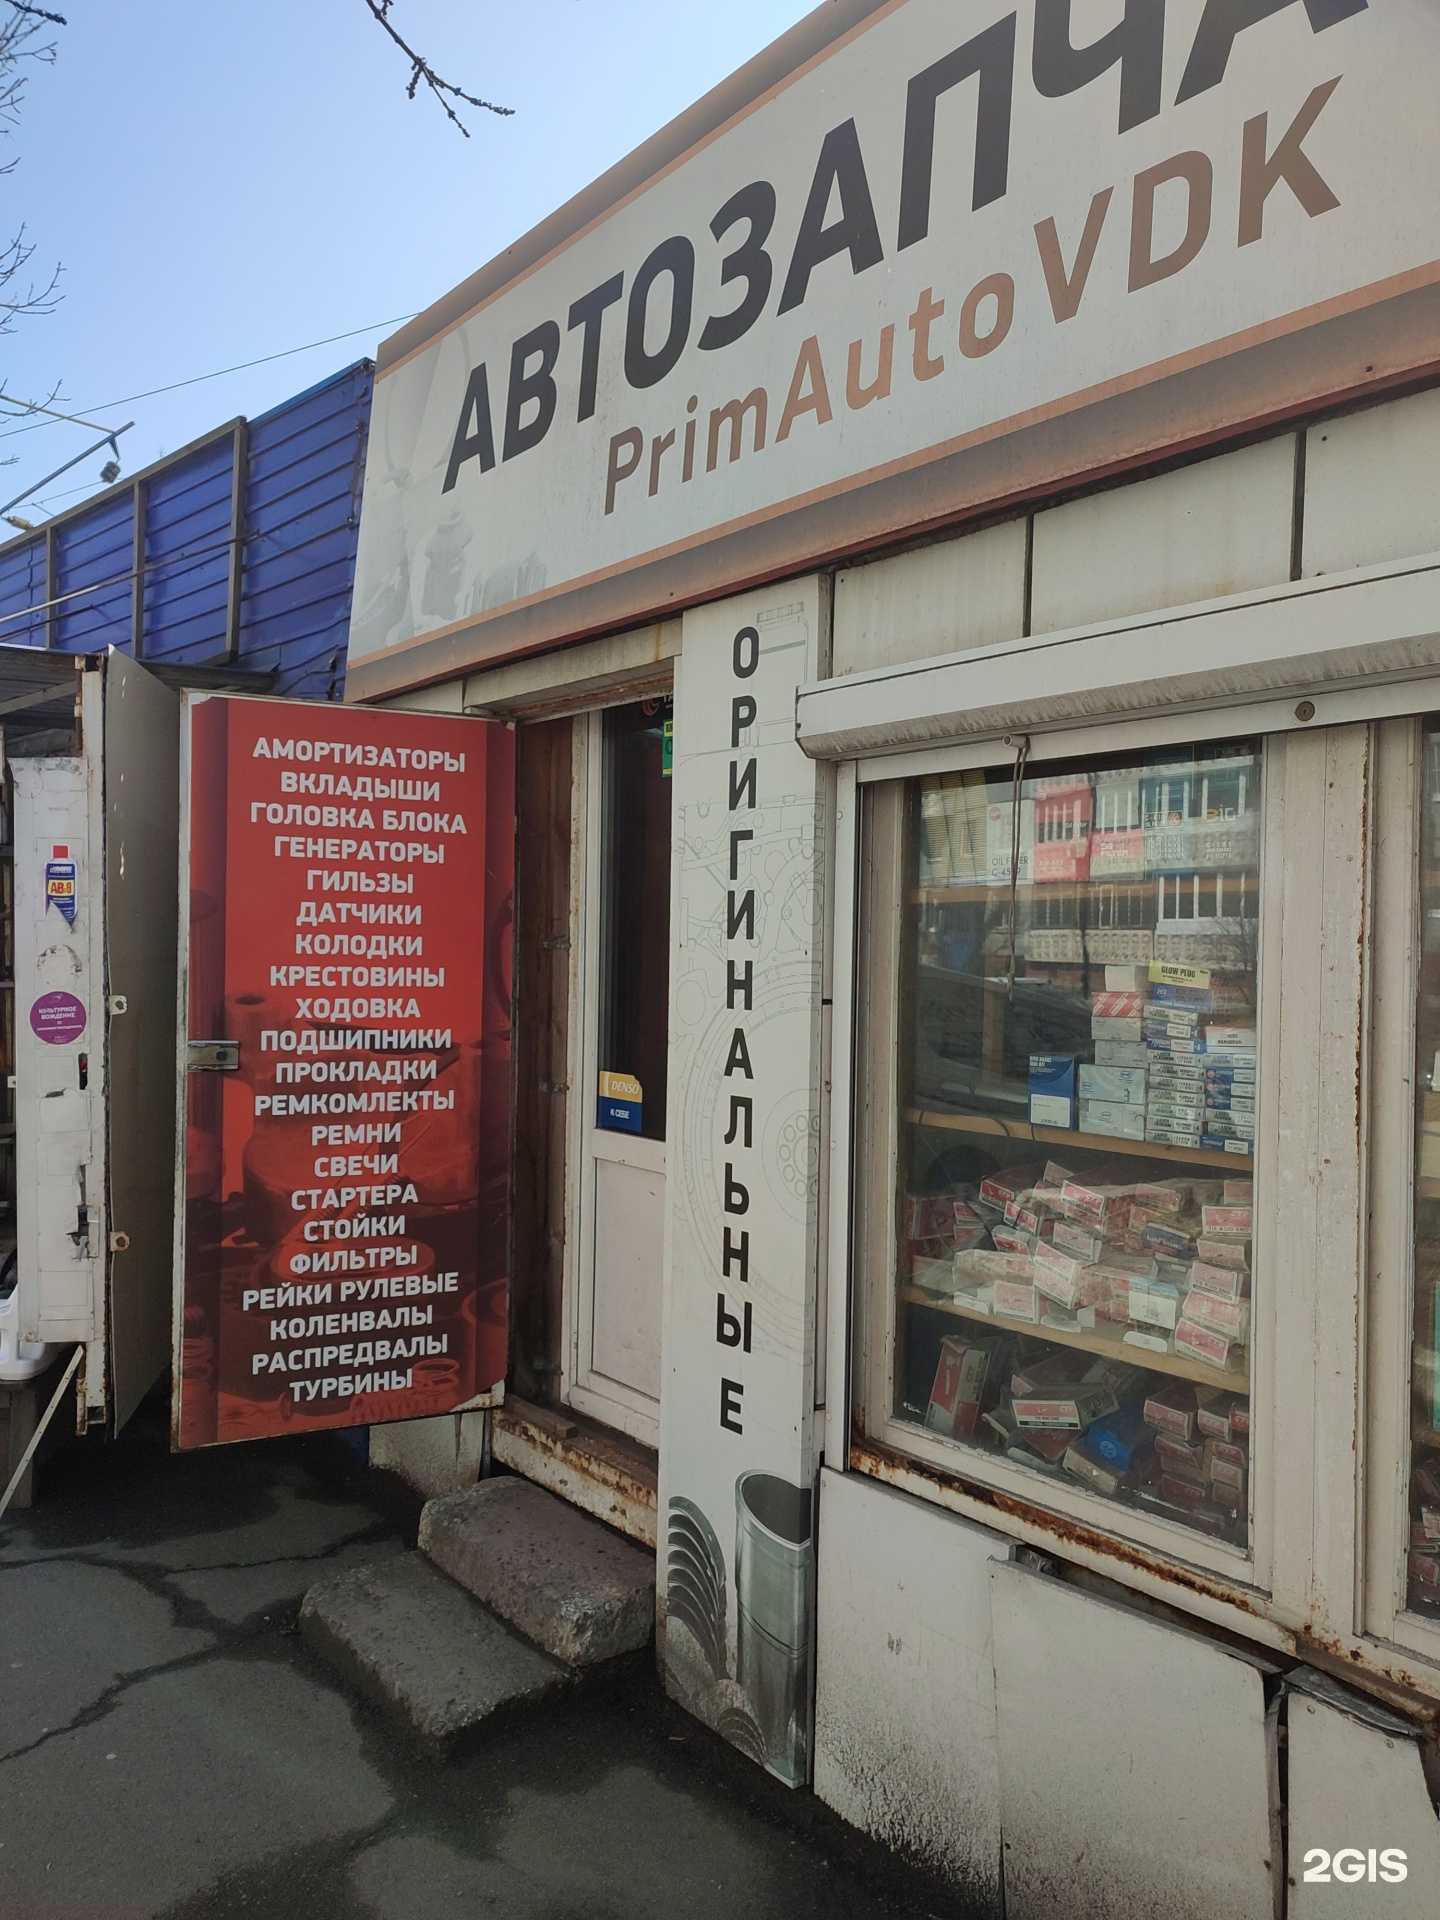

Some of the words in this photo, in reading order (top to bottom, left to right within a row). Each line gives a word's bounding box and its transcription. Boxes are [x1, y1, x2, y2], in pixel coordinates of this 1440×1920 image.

[252, 737, 465, 773] АМОРТИЗАТОРЫ
[280, 771, 440, 802] ВКЛАДЫШИ
[250, 802, 375, 829] ГОЛОВКА
[382, 809, 468, 834] БЛОКА
[274, 836, 445, 864] ГЕНЕРАТОРЫ
[306, 869, 413, 894] ГИЛЬЗЫ
[296, 901, 422, 927] ДАТЧИКИ
[295, 933, 423, 960] КОЛОДКИ
[270, 965, 445, 987] КРЕСТОВИНЫ
[295, 998, 421, 1022] ХОДОВКА
[260, 1028, 451, 1055] ПОДШИПНИКИ
[716, 626, 760, 1435] ОРИГИНАЛЬНЫЕ
[275, 1060, 437, 1084] ПРОКЛАДКИ
[611, 1080, 640, 1095] DENSO
[255, 1090, 454, 1116] РЕМКОМЛЕКТЫ
[311, 1122, 401, 1146] РЕМНИ
[314, 1154, 398, 1178] СВЕЧИ
[291, 1183, 418, 1211] СТАРТЕРА
[303, 1213, 406, 1242] СТОЙКИ
[289, 1245, 417, 1274] ФИЛЬТРЫ
[242, 1281, 332, 1311] РЕЙКИ
[340, 1272, 459, 1302] РУЛЕВЫЕ
[270, 1305, 433, 1341] КОЛЕНВАЛЫ
[252, 1333, 448, 1375] РАСПРЕДВАЛЫ
[289, 1368, 412, 1402] ТУРБИНЫ
